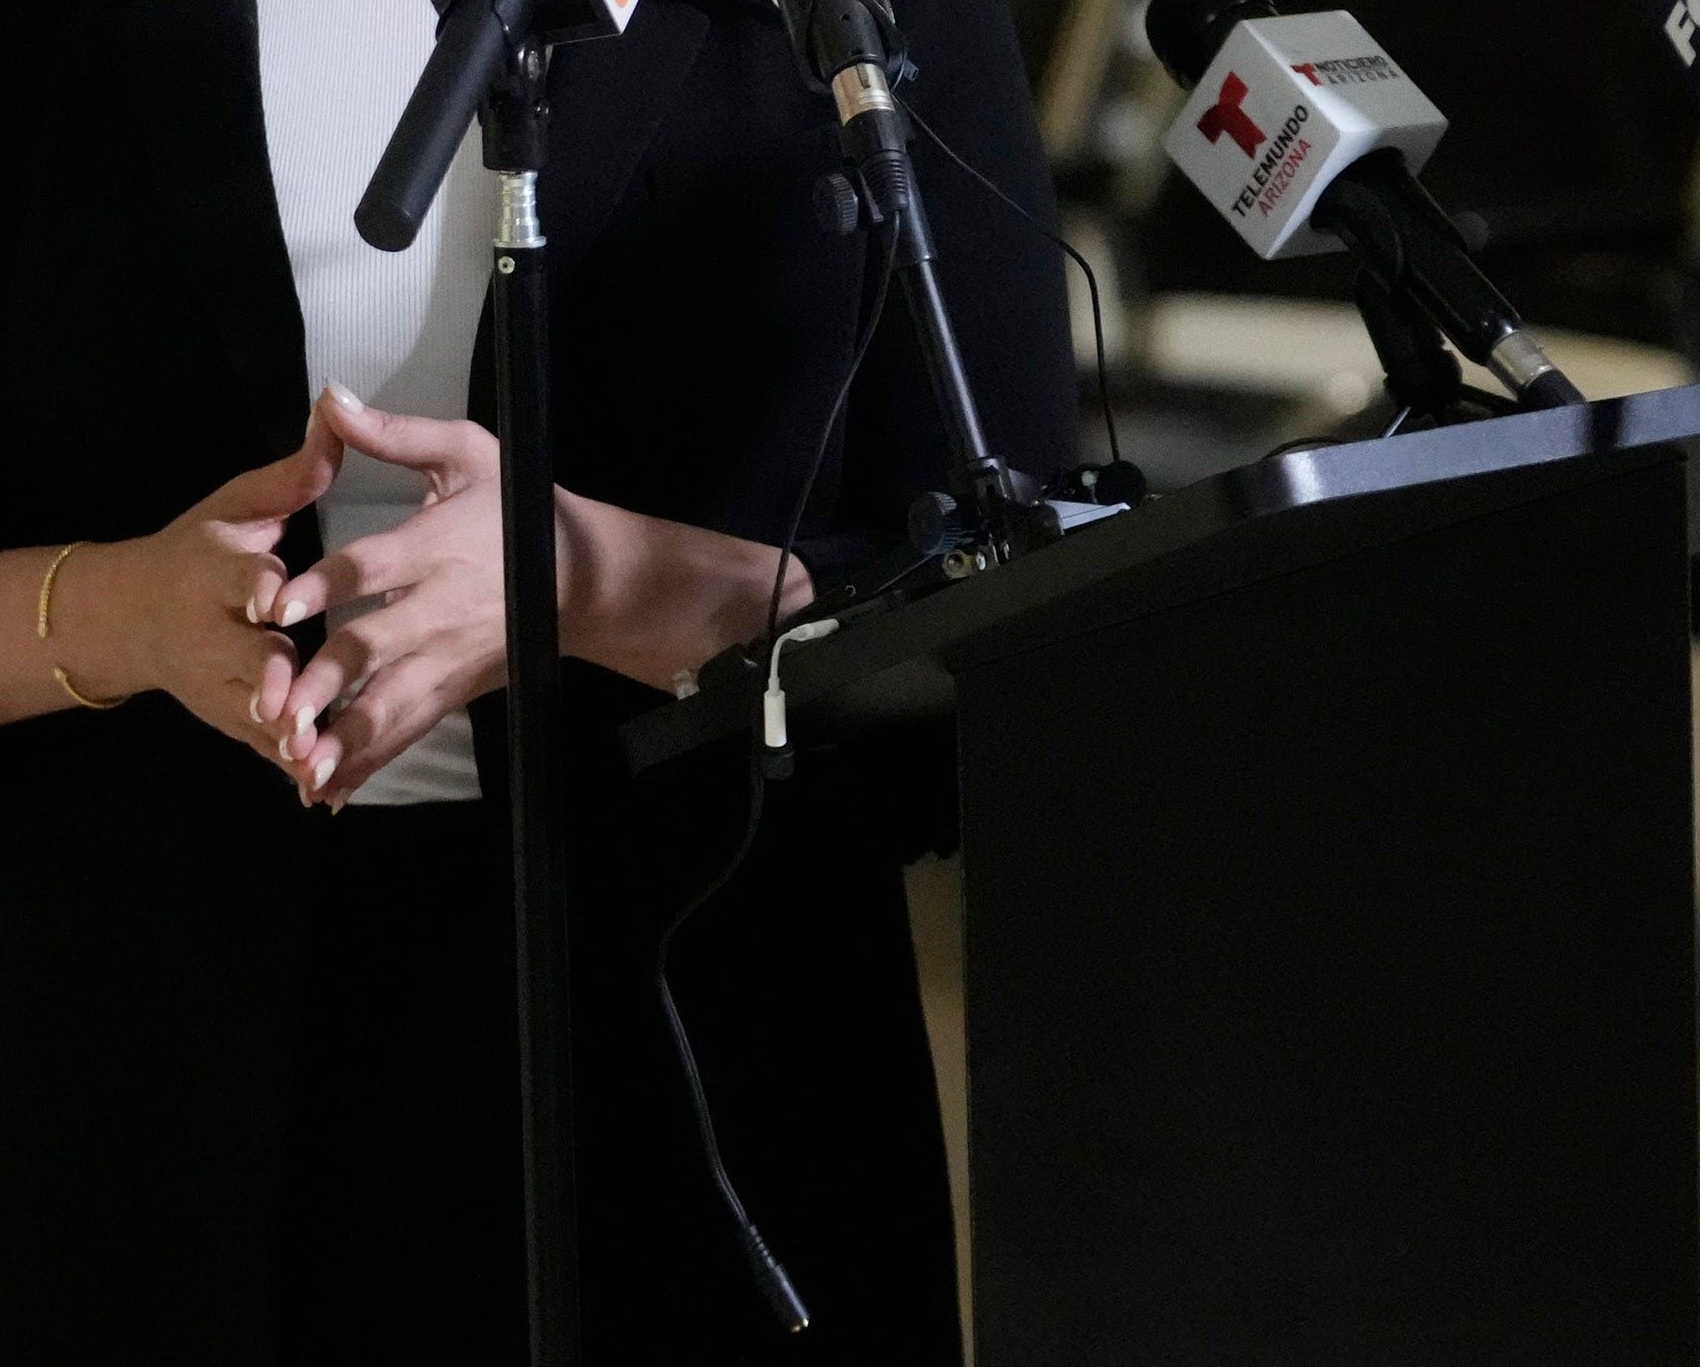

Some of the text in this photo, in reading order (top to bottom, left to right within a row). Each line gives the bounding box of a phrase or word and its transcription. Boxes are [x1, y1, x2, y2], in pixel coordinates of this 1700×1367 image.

[1314, 55, 1388, 72] NOTICIERO
[1327, 67, 1398, 85] ARIZONA
[1232, 105, 1308, 217] TELEMUNDO
[1258, 139, 1312, 217] ARIZONA
